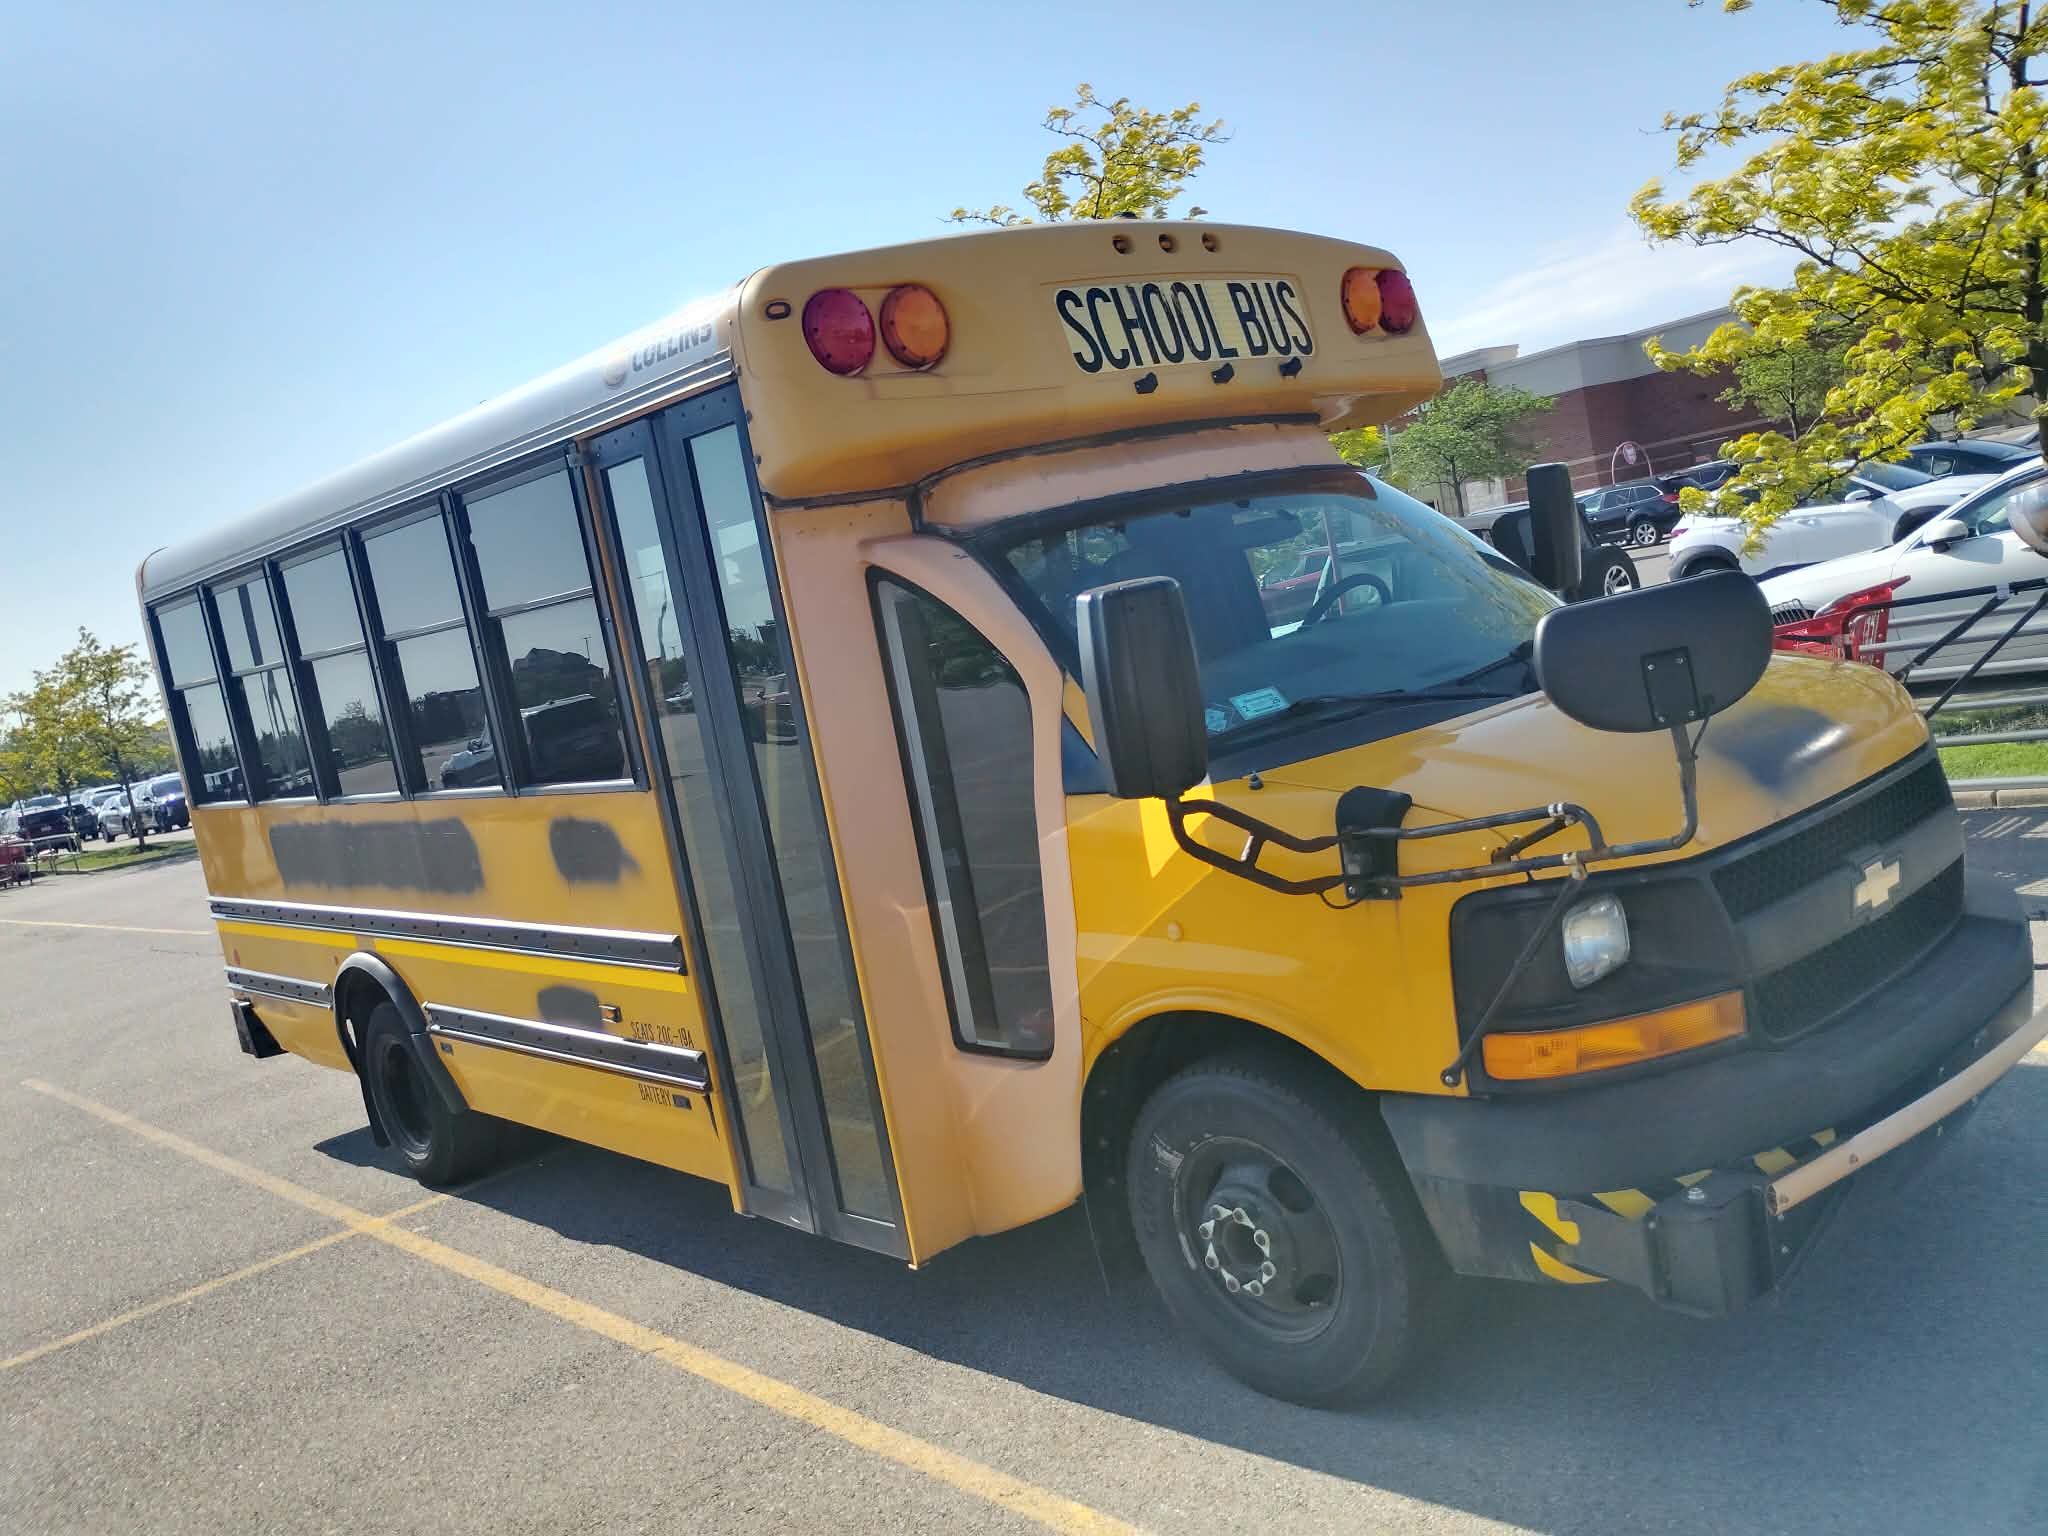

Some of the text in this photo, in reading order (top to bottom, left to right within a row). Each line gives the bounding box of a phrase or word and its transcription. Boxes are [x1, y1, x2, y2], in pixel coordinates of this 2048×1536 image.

[1056, 281, 1313, 373] SCHOOL BUS
[631, 1021, 655, 1041] SEATS
[639, 1083, 671, 1106] BATTERY
